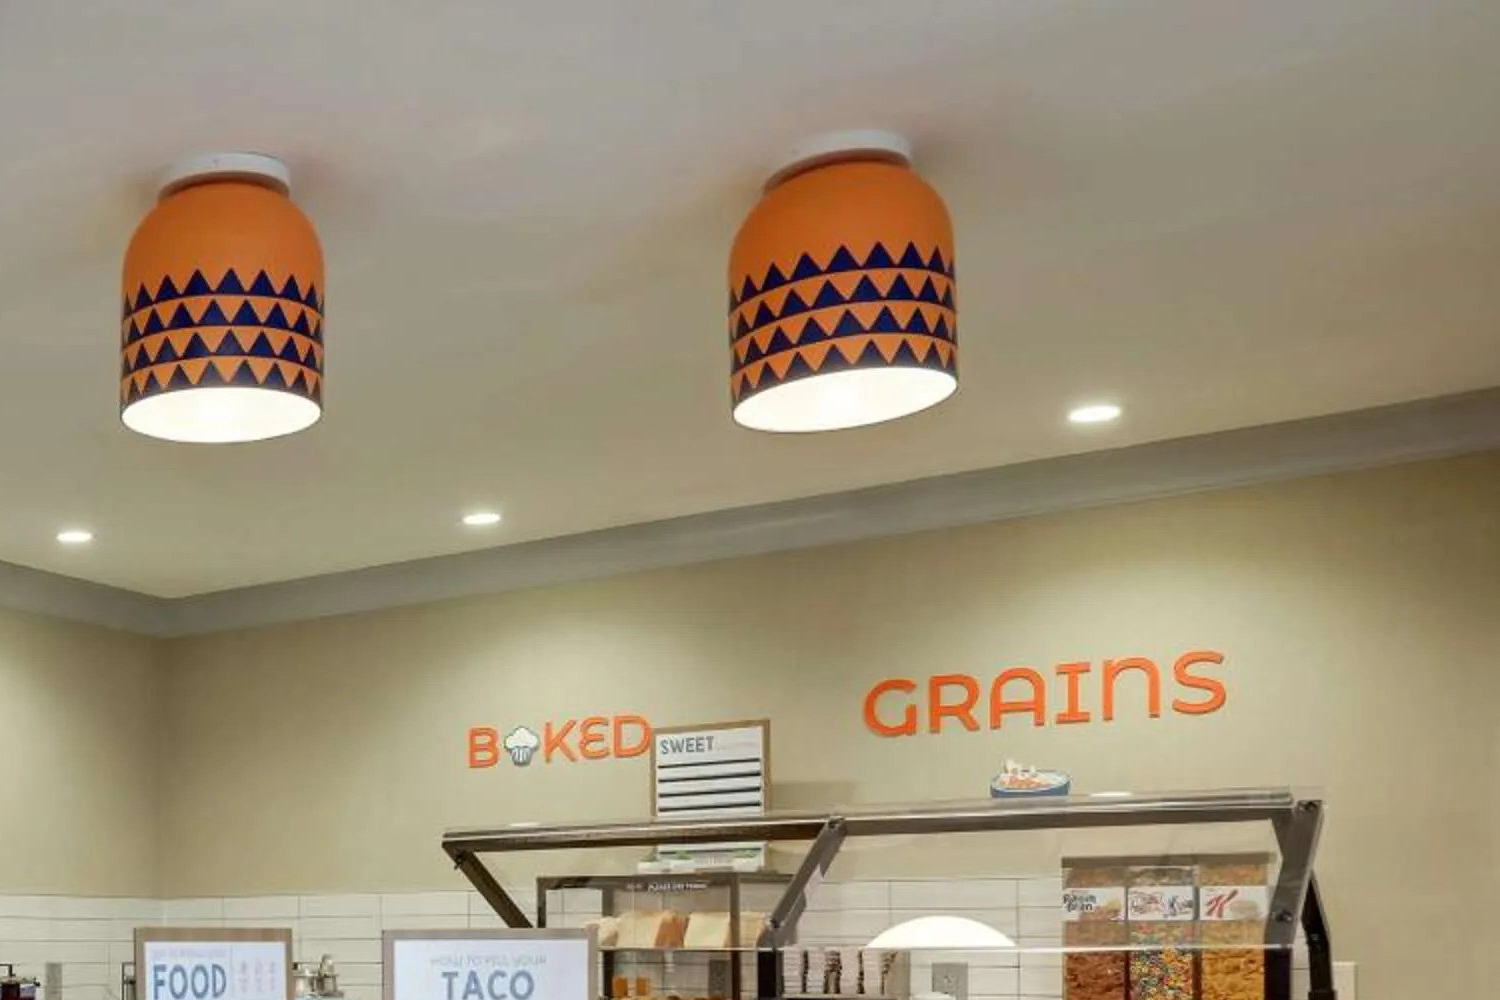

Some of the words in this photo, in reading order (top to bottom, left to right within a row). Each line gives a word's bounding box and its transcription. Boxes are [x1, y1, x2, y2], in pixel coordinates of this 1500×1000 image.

[861, 650, 1227, 738] GRAINS
[468, 714, 651, 768] BKED
[659, 735, 715, 755] SWEET
[153, 963, 227, 1000] FOOD
[441, 969, 535, 1000] TACO
